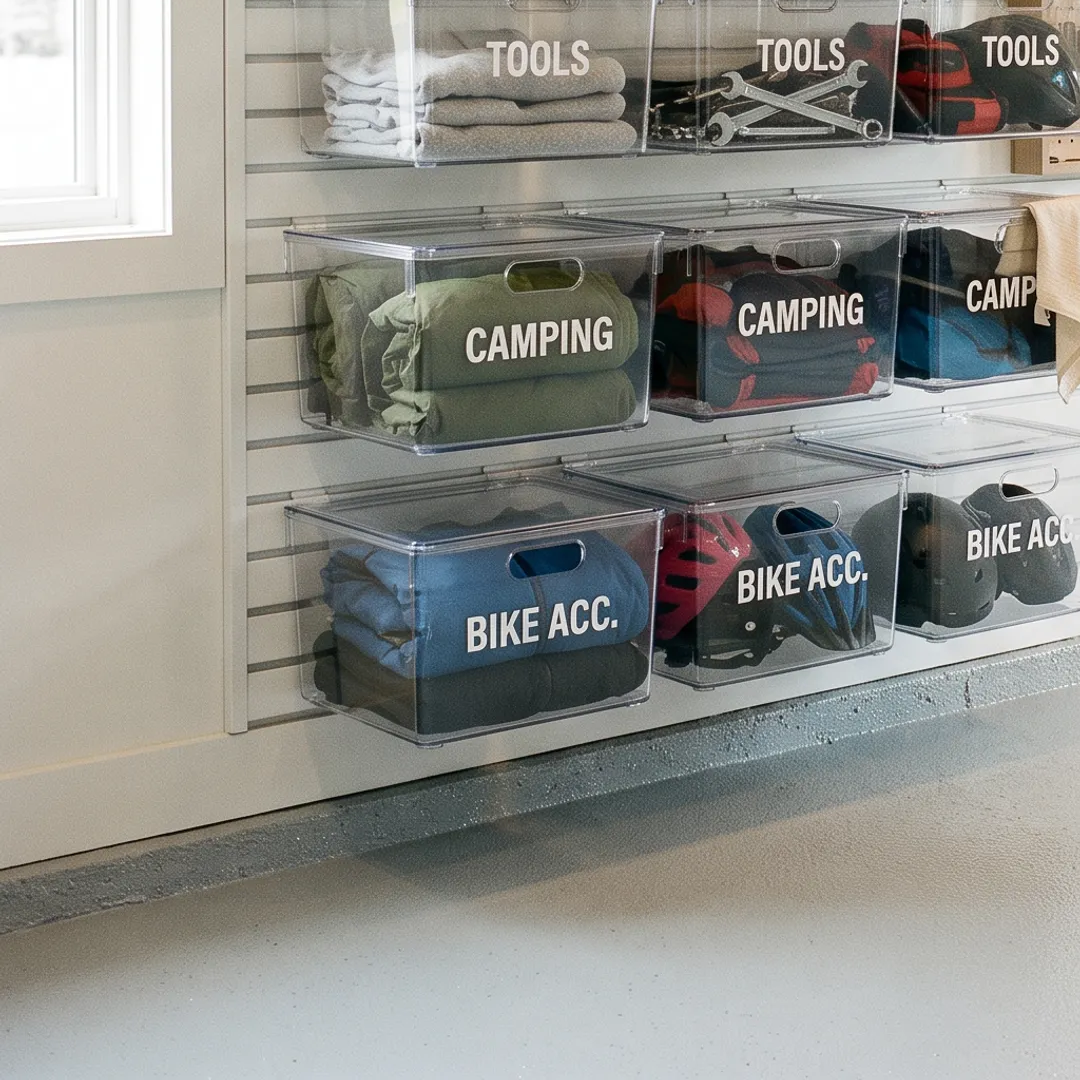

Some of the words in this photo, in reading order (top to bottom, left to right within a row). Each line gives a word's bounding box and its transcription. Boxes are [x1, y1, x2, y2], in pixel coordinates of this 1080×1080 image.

[487, 40, 590, 77] TOOLS
[757, 38, 845, 71] TOOLS
[982, 35, 1059, 67] TOOLS
[966, 275, 1036, 312] CAMP
[738, 293, 863, 336] CAMPING
[466, 316, 613, 363] CAMPING
[967, 522, 1021, 560] BIKE
[738, 565, 800, 603] BIKE
[808, 550, 868, 589] ACC.
[468, 606, 538, 651] BIKE
[548, 595, 618, 637] ACC.
